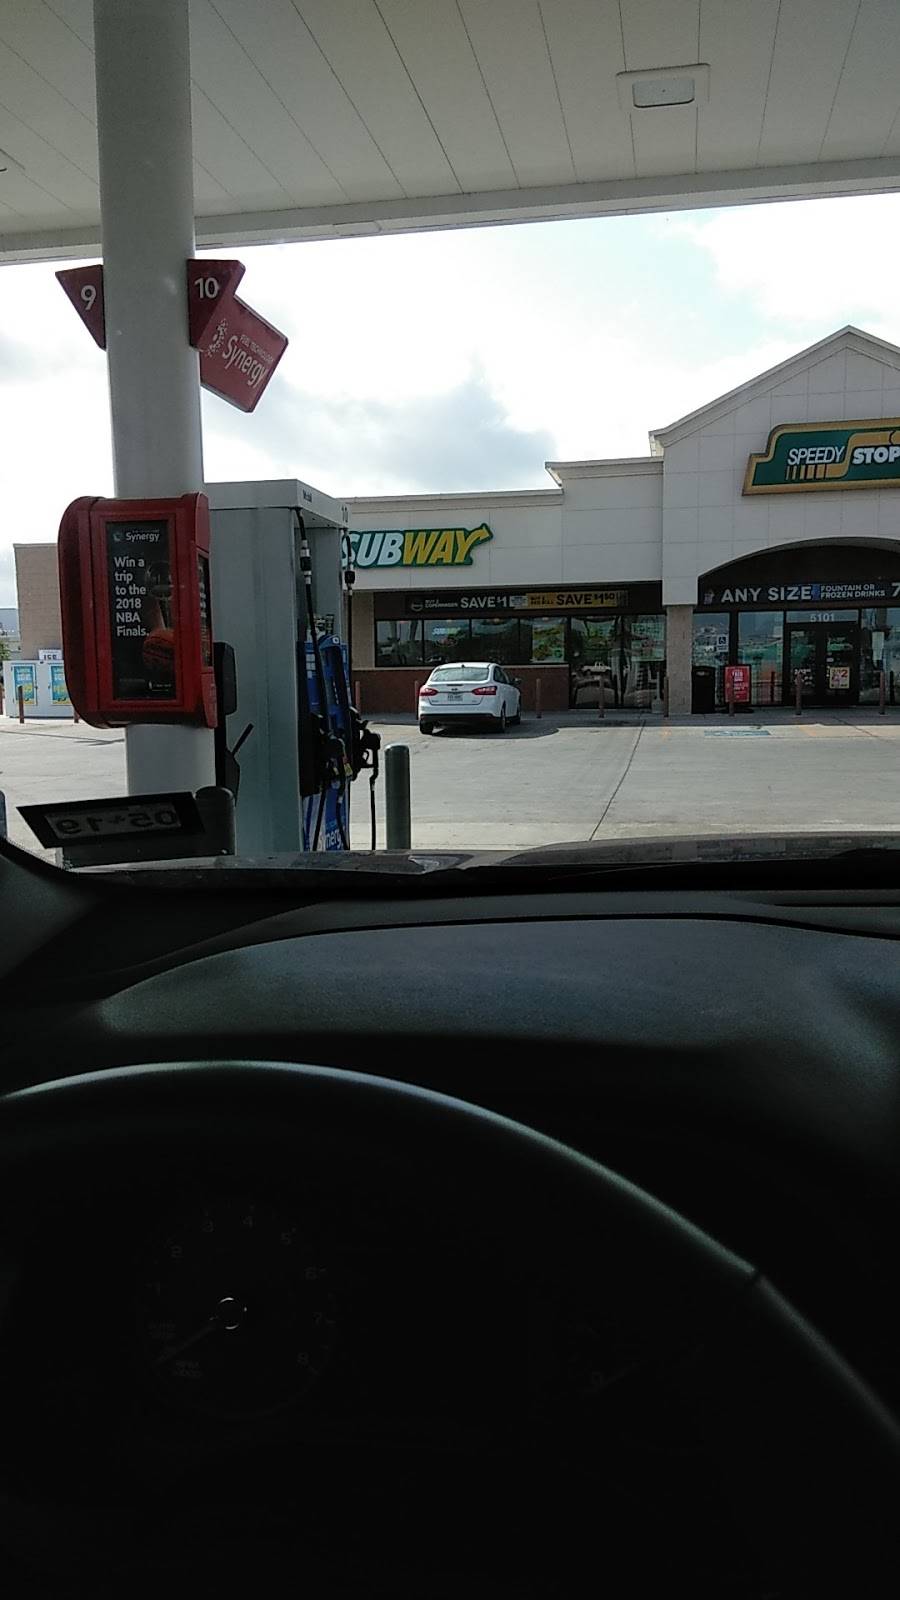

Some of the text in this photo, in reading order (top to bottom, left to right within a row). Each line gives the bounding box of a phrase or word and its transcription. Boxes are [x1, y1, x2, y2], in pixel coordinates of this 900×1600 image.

[194, 277, 220, 300] 10
[80, 284, 97, 311] 9
[221, 335, 269, 389] Synergy
[787, 445, 900, 466] SPEEDY STOP
[125, 531, 160, 542] Synergy
[341, 523, 490, 568] SUBWAY
[113, 556, 146, 568] Win a
[114, 570, 134, 584] trip
[115, 583, 147, 596] to the
[820, 583, 875, 592] FOUNTAIN OR
[556, 593, 593, 606] SAVE
[720, 585, 812, 604] ANY SIZE
[820, 590, 886, 599] FROZEN DRINKS
[115, 598, 142, 610] 2018
[460, 596, 496, 609] SAVE
[116, 612, 142, 623] NBA
[810, 613, 835, 623] 5101
[116, 625, 151, 637] Finals.
